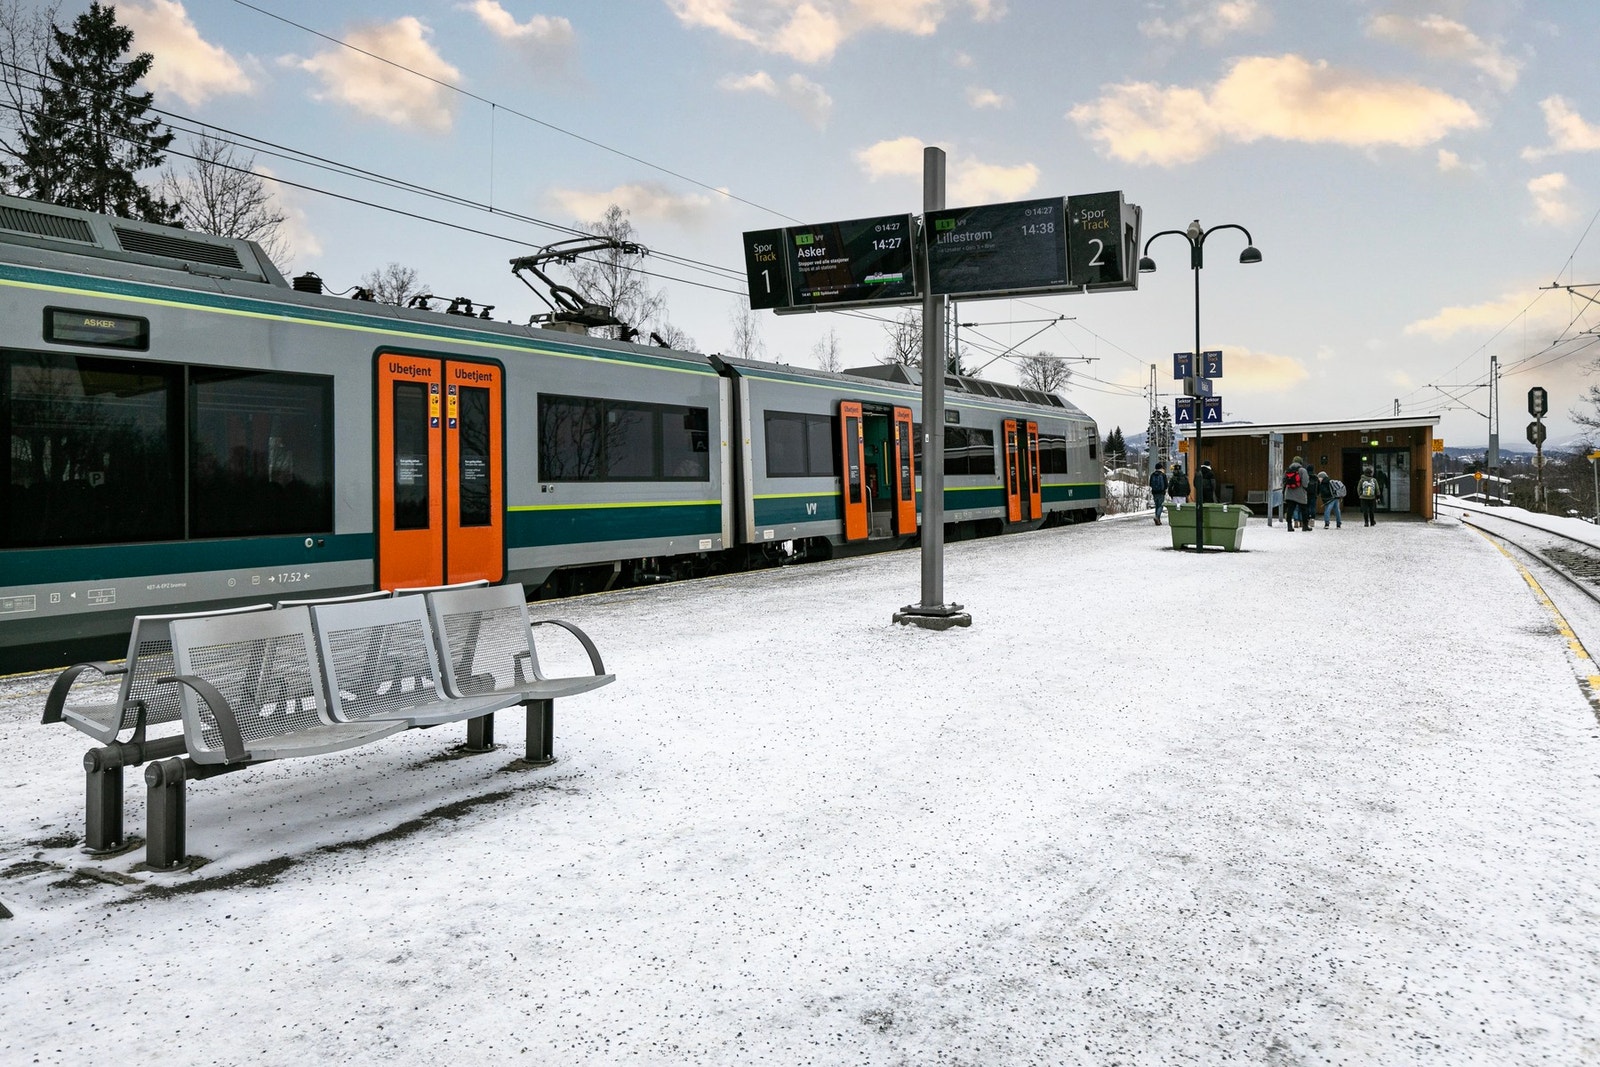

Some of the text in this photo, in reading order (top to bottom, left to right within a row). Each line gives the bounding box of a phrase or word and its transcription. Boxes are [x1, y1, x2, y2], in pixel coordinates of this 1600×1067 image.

[1033, 206, 1053, 216] 14:27
[1081, 209, 1106, 220] Spor
[882, 222, 900, 232] 14:27
[1022, 222, 1054, 236] 14:38
[1082, 218, 1110, 230] Track
[936, 230, 992, 244] Lillestrøm
[754, 243, 772, 254] Spor
[872, 238, 902, 250] 14:27
[754, 252, 776, 262] Track
[798, 246, 826, 258] Asker
[1088, 238, 1105, 266] 2
[762, 270, 770, 294] 1
[84, 318, 115, 328] ASKER
[389, 362, 432, 378] Ubetjent
[1180, 365, 1185, 374] 1
[1210, 363, 1216, 374] 2
[454, 368, 492, 382] Ubetjent
[1180, 409, 1188, 420] A
[1208, 408, 1217, 419] A
[278, 572, 301, 583] 17.52
